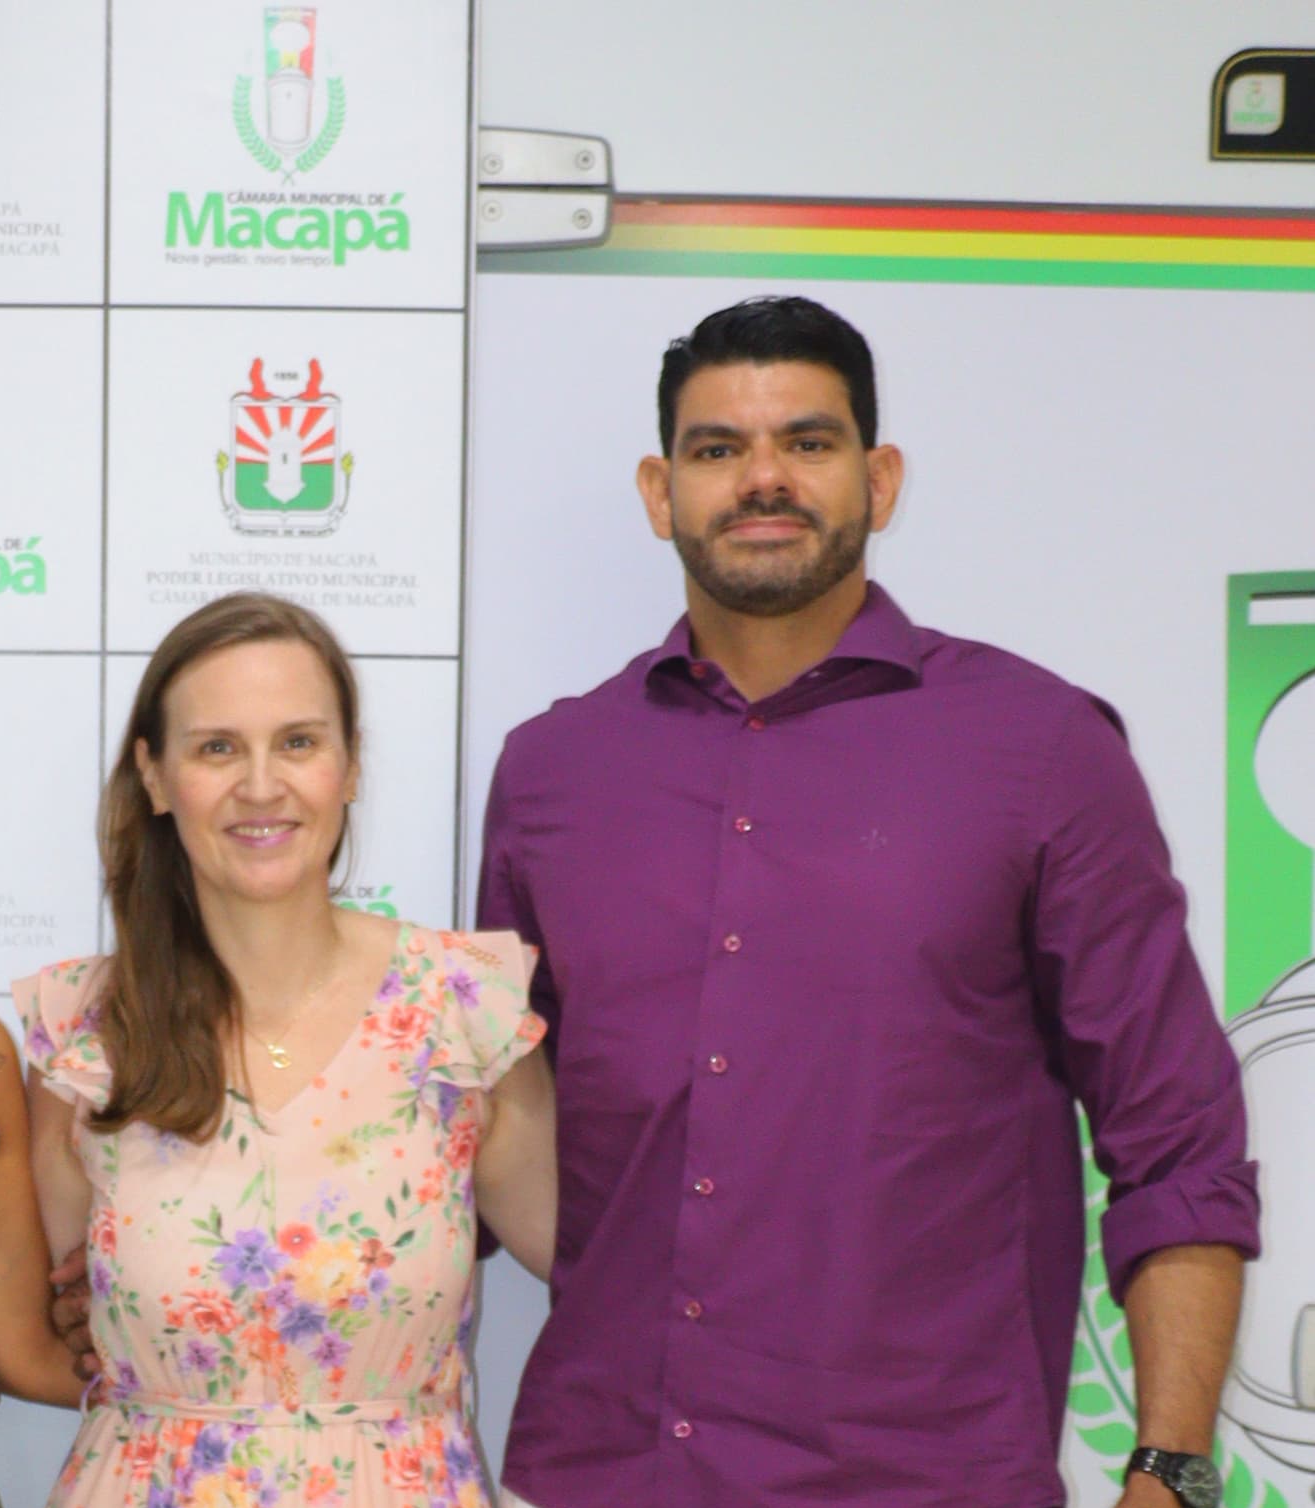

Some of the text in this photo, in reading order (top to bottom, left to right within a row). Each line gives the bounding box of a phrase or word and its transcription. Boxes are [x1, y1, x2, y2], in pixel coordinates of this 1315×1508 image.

[227, 189, 386, 205] CÂMARA MUNICIPAL DE
[165, 192, 410, 266] Macapá
[166, 253, 199, 265] Nova
[255, 254, 285, 265] novo
[290, 253, 331, 266] tempo
[5, 538, 22, 549] DE
[146, 571, 419, 588] PODER LEGISLATIVO MUNICIPAL
